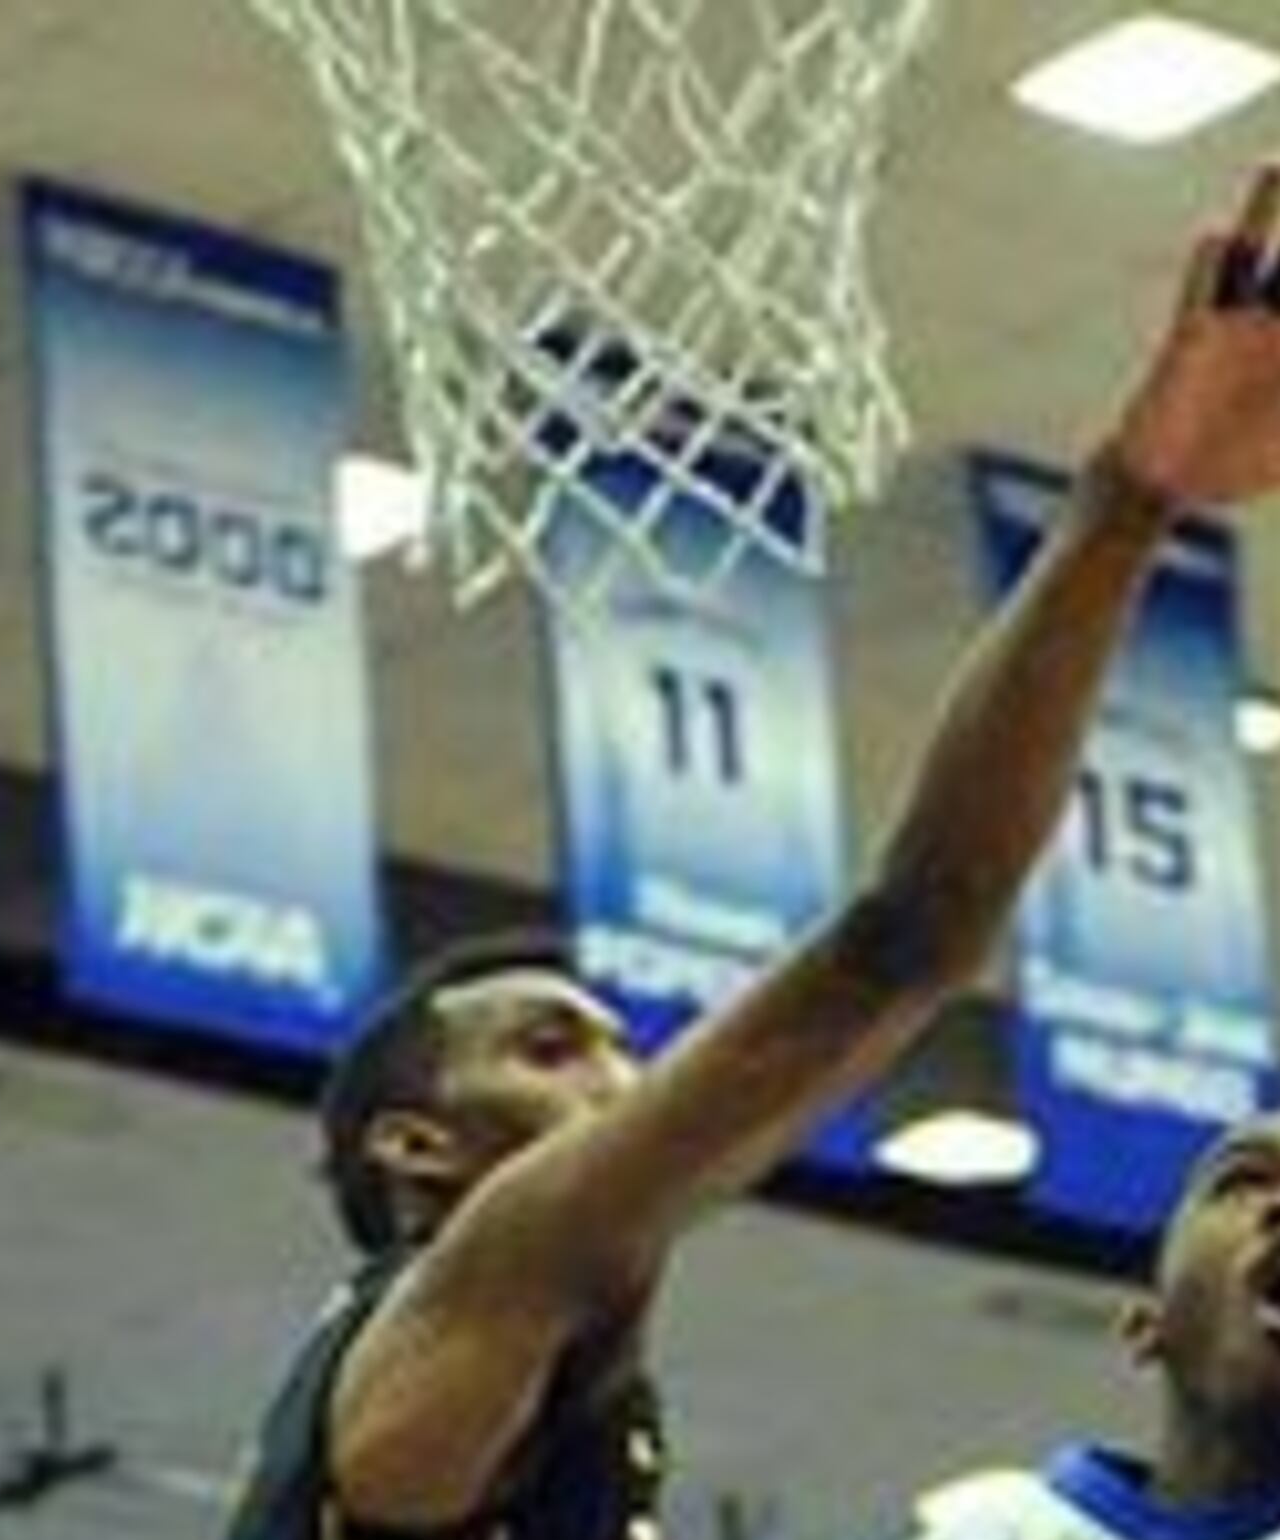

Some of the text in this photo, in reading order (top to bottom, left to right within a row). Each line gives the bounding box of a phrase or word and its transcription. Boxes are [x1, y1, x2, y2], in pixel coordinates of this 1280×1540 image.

[80, 472, 326, 605] 2000
[652, 666, 743, 785] 11
[1074, 771, 1197, 888] 15
